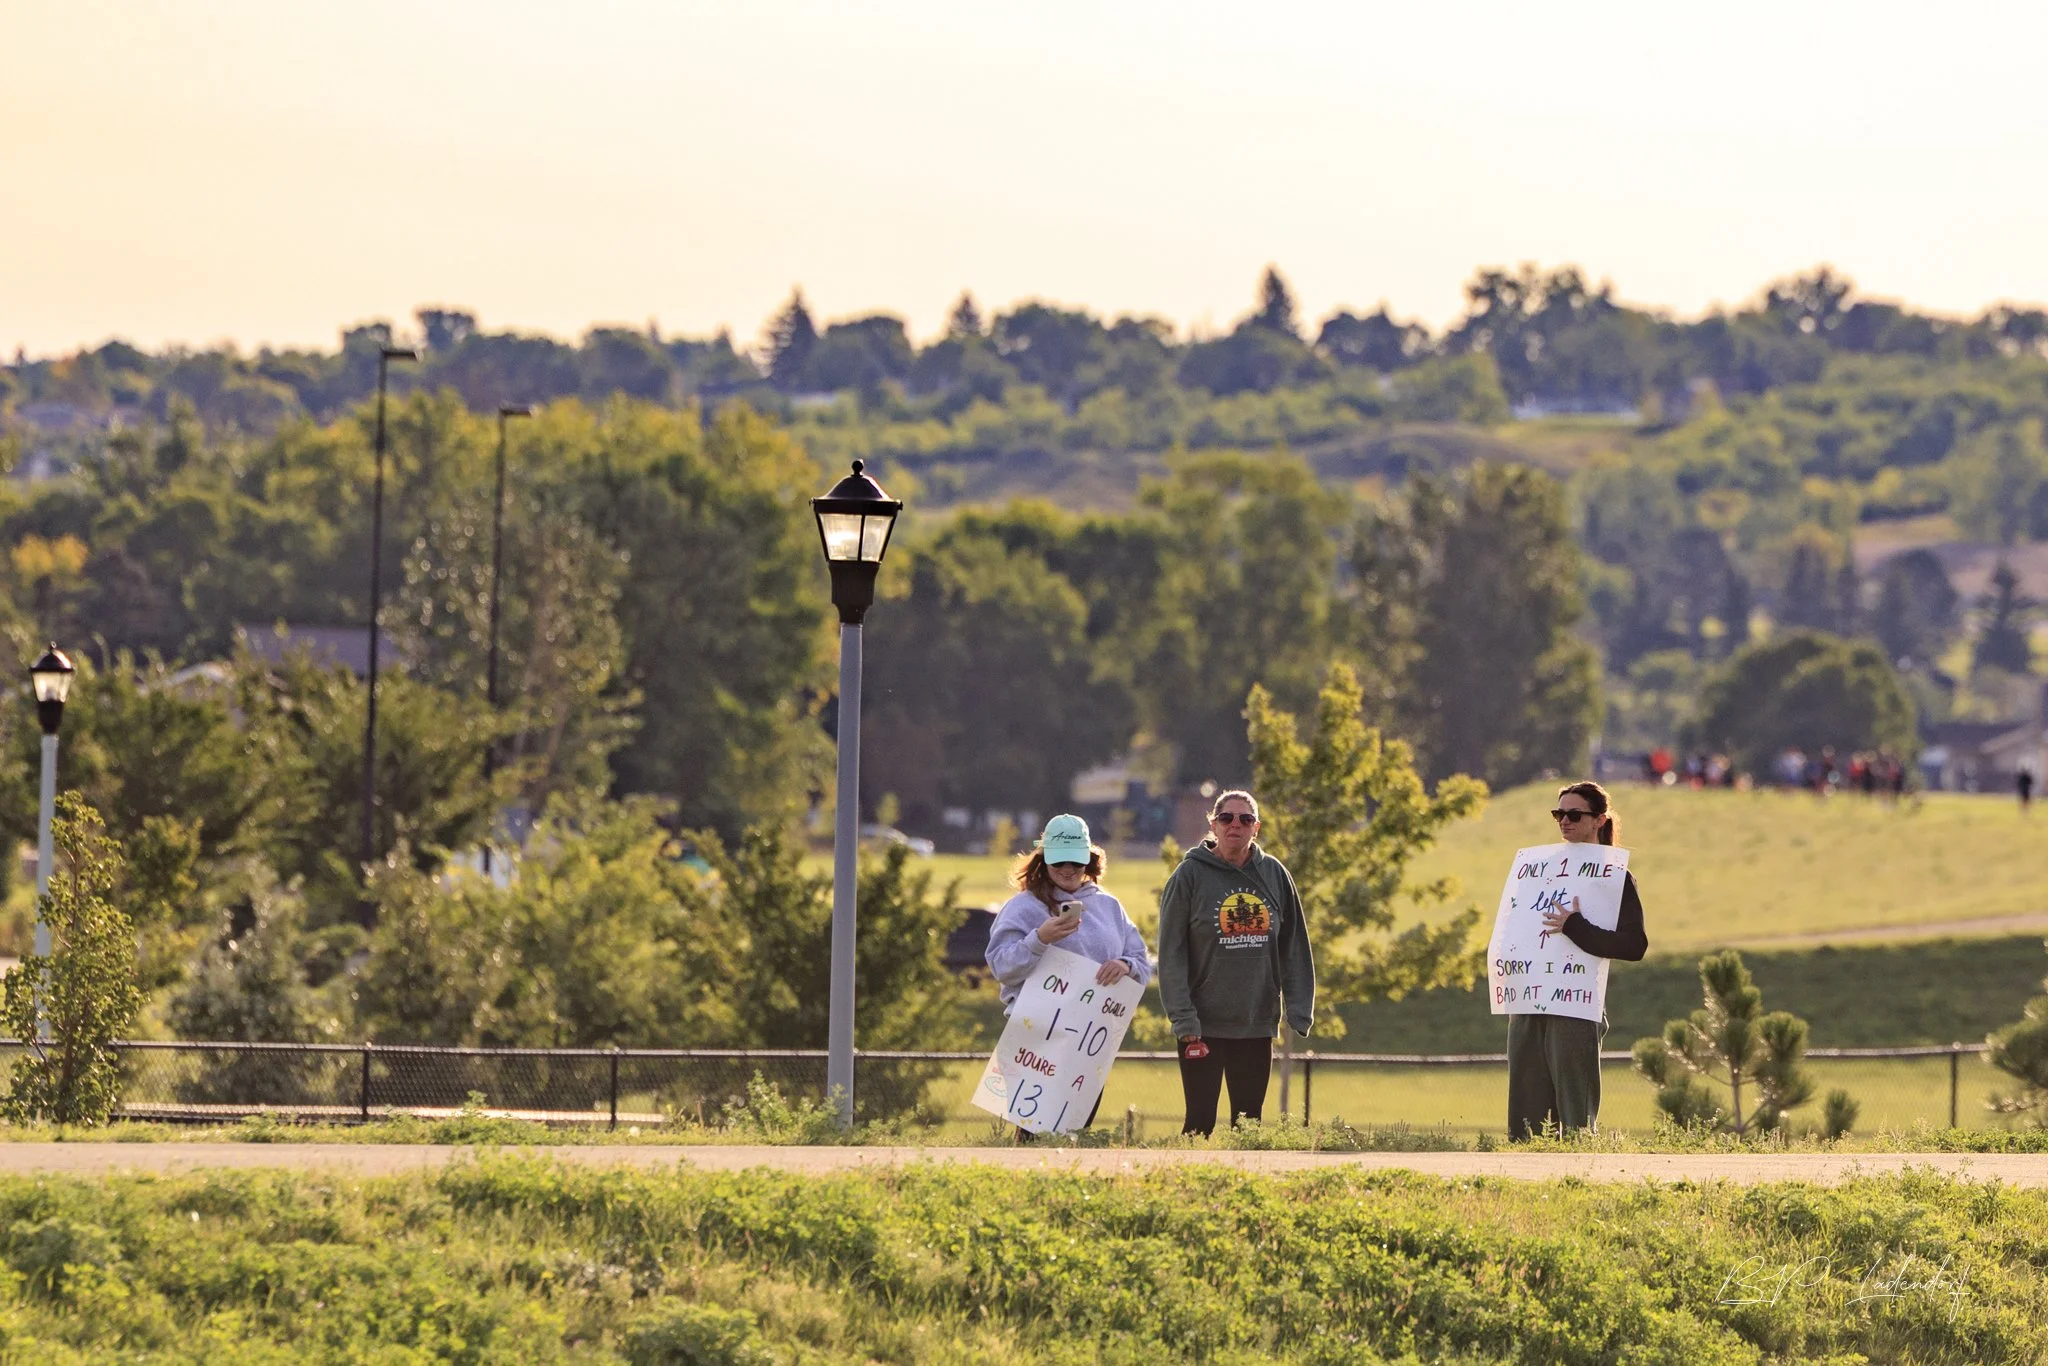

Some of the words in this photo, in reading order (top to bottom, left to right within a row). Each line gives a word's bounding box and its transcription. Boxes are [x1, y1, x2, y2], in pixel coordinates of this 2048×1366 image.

[1517, 862, 1548, 879] ONLY
[1556, 858, 1569, 878] 1
[1578, 862, 1613, 878] MILE
[1530, 887, 1571, 920] left
[1219, 934, 1269, 944] michigan
[1496, 959, 1532, 977] SORRY
[1545, 962, 1554, 974] I
[1043, 974, 1069, 995] ON
[1080, 989, 1095, 1004] A
[1496, 986, 1517, 1004] BAD
[1523, 985, 1543, 1001] AT
[1551, 988, 1592, 1004] MATH
[1046, 1008, 1108, 1057] 1-10
[1071, 1075, 1085, 1092] A
